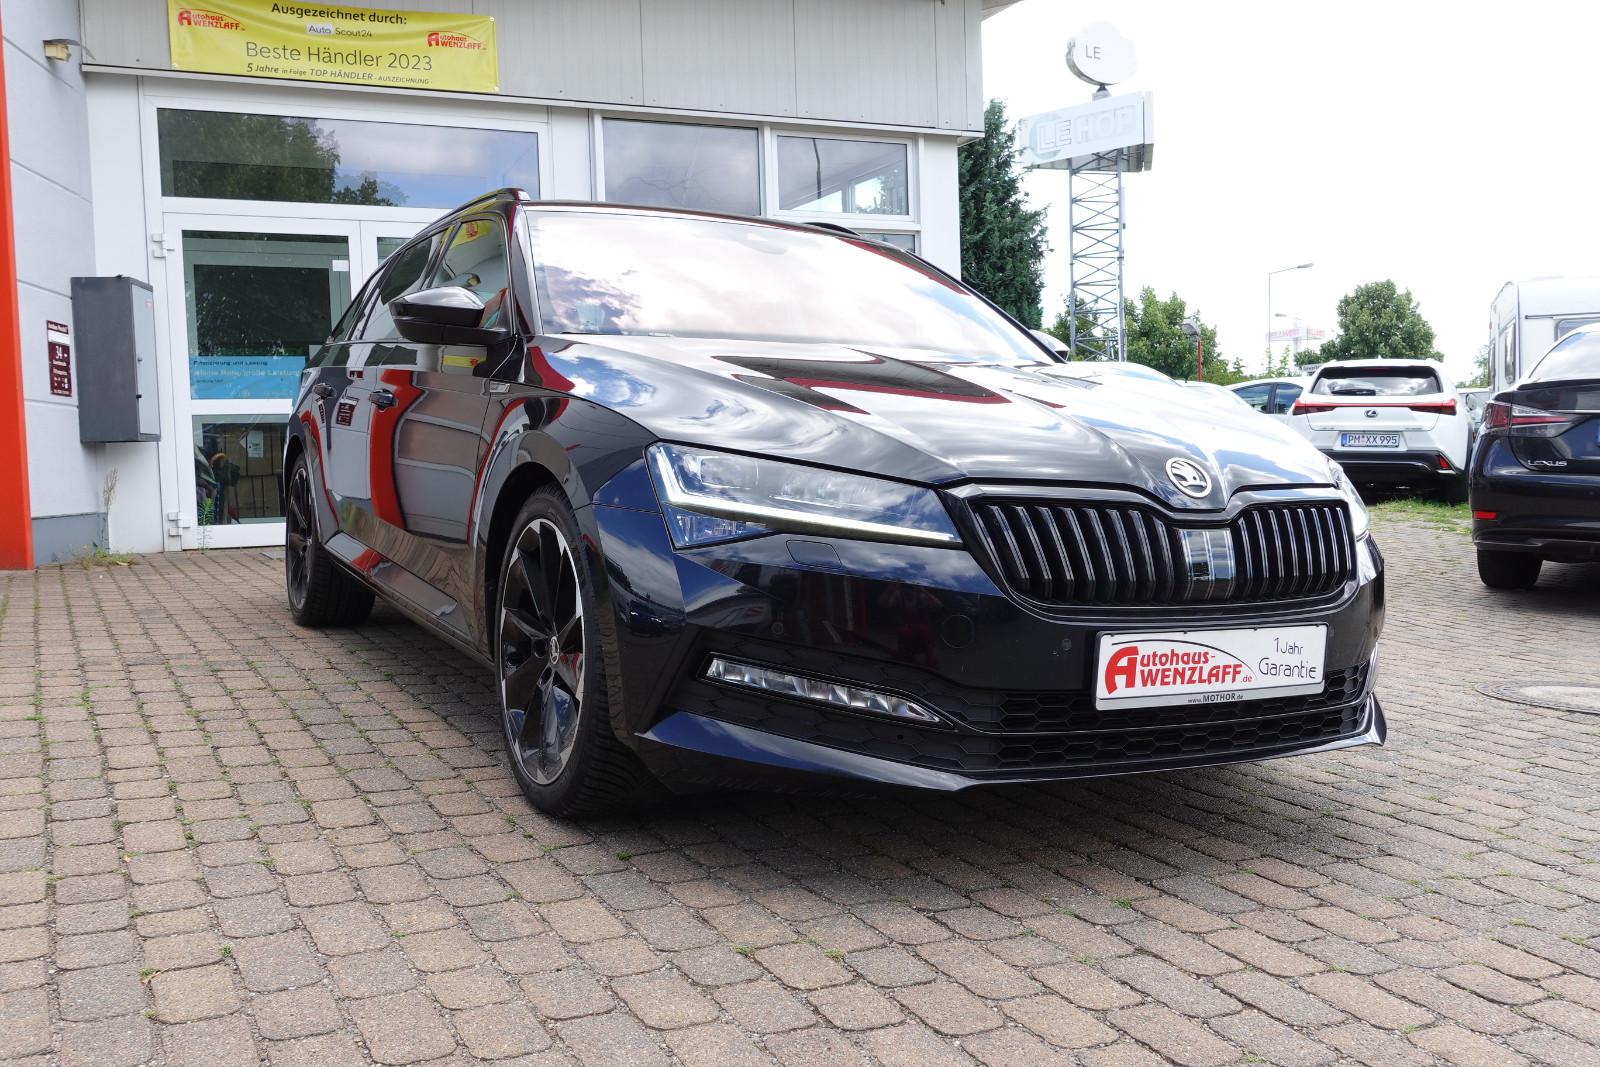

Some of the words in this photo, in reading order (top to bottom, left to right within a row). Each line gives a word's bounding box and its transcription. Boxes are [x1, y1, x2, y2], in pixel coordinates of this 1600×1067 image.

[271, 3, 365, 22] Ausgezeichnet
[368, 11, 407, 25] durch:
[193, 19, 240, 31] WENZLAFF
[246, 41, 301, 61] Beste
[308, 47, 382, 67] Händler
[387, 52, 433, 71] 2023
[1085, 45, 1102, 60] LE
[246, 62, 253, 72] 5
[255, 64, 279, 74] Jahre
[310, 69, 328, 77] TOP
[330, 69, 373, 80] HÄNDLER
[378, 75, 430, 85] AUSZEICHNUNG
[1348, 435, 1361, 445] PM
[1366, 435, 1378, 445] XX
[1379, 435, 1398, 445] 995
[1527, 459, 1567, 467] LEXUS
[1258, 657, 1317, 680] Garantie
